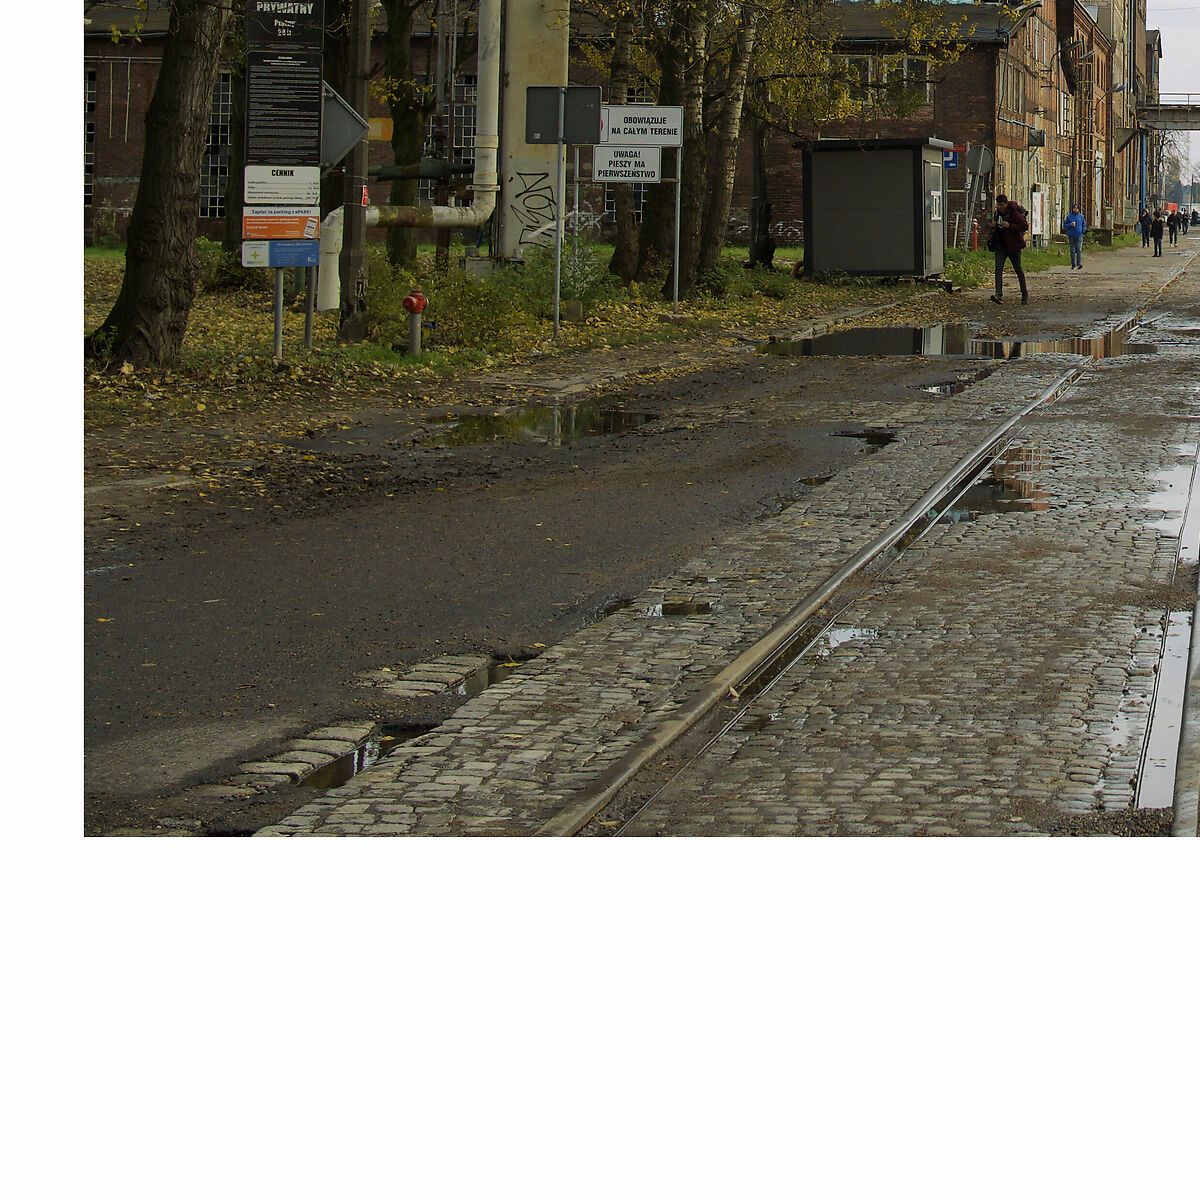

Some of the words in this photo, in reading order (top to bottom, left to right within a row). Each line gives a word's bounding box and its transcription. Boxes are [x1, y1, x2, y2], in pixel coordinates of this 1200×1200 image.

[256, 2, 314, 14] PRYWATNY
[623, 116, 667, 125] OBOWIĄZUJE
[611, 127, 621, 135] NA
[623, 127, 648, 135] CAŁYM
[650, 127, 678, 136] TERENIE
[608, 160, 632, 168] PIESZY
[634, 160, 646, 168] MA
[271, 169, 295, 177] CENNIK
[598, 168, 656, 178] PIERWSZEŃSTWO
